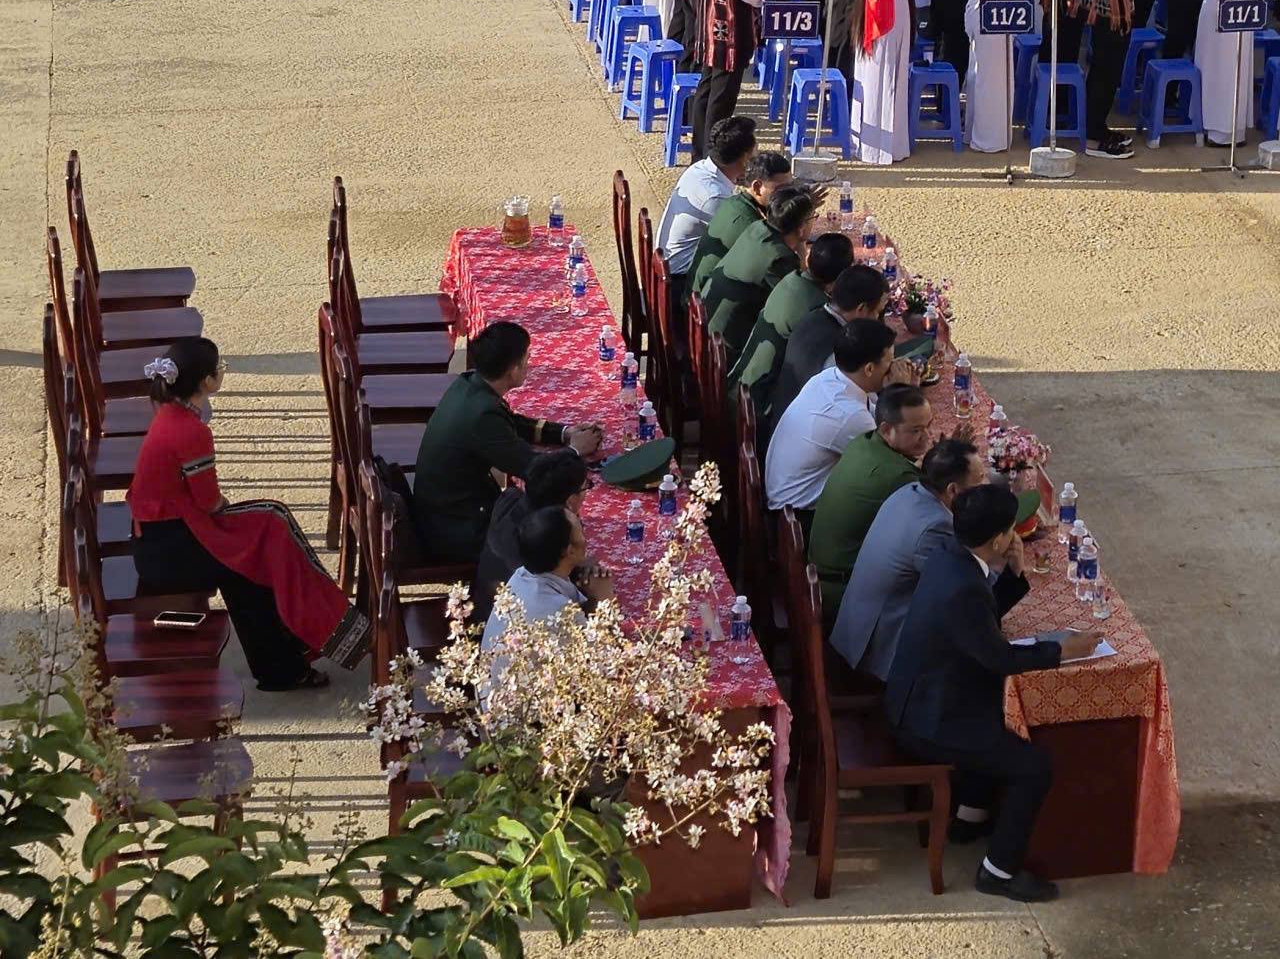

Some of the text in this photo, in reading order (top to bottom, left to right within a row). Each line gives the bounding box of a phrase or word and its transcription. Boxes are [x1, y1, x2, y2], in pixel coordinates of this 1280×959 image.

[771, 11, 813, 31] 11/3
[990, 7, 1027, 26] 11/2
[1227, 5, 1260, 24] 11/1
